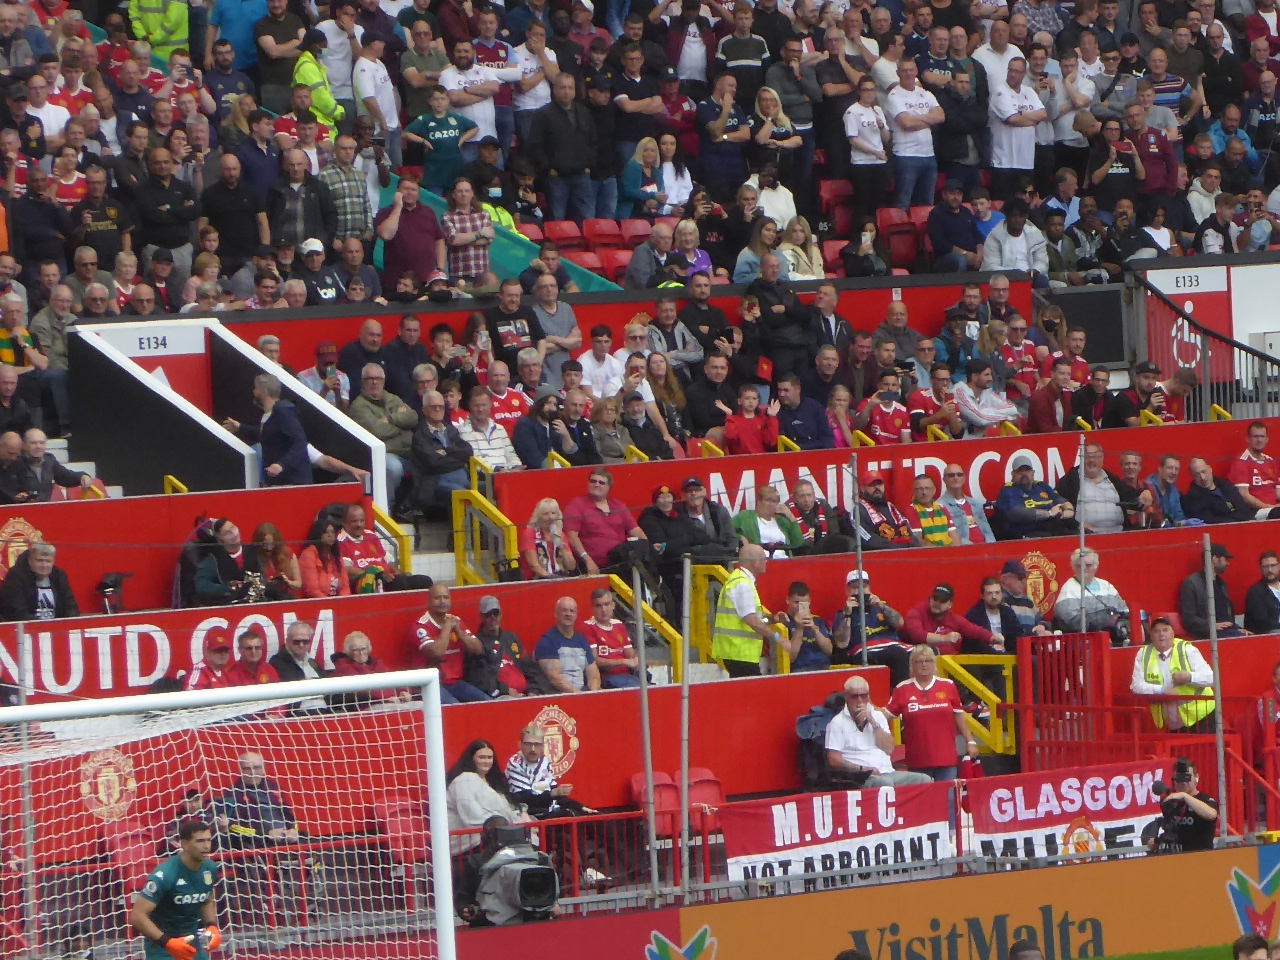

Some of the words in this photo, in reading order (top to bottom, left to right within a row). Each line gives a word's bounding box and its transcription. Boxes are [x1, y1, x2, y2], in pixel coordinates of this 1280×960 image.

[1175, 275, 1199, 288] E133
[138, 336, 168, 350] E134
[536, 709, 573, 733] ANCHESTER
[989, 768, 1164, 823] GLASGOW
[771, 786, 904, 847] M.U.F.C.
